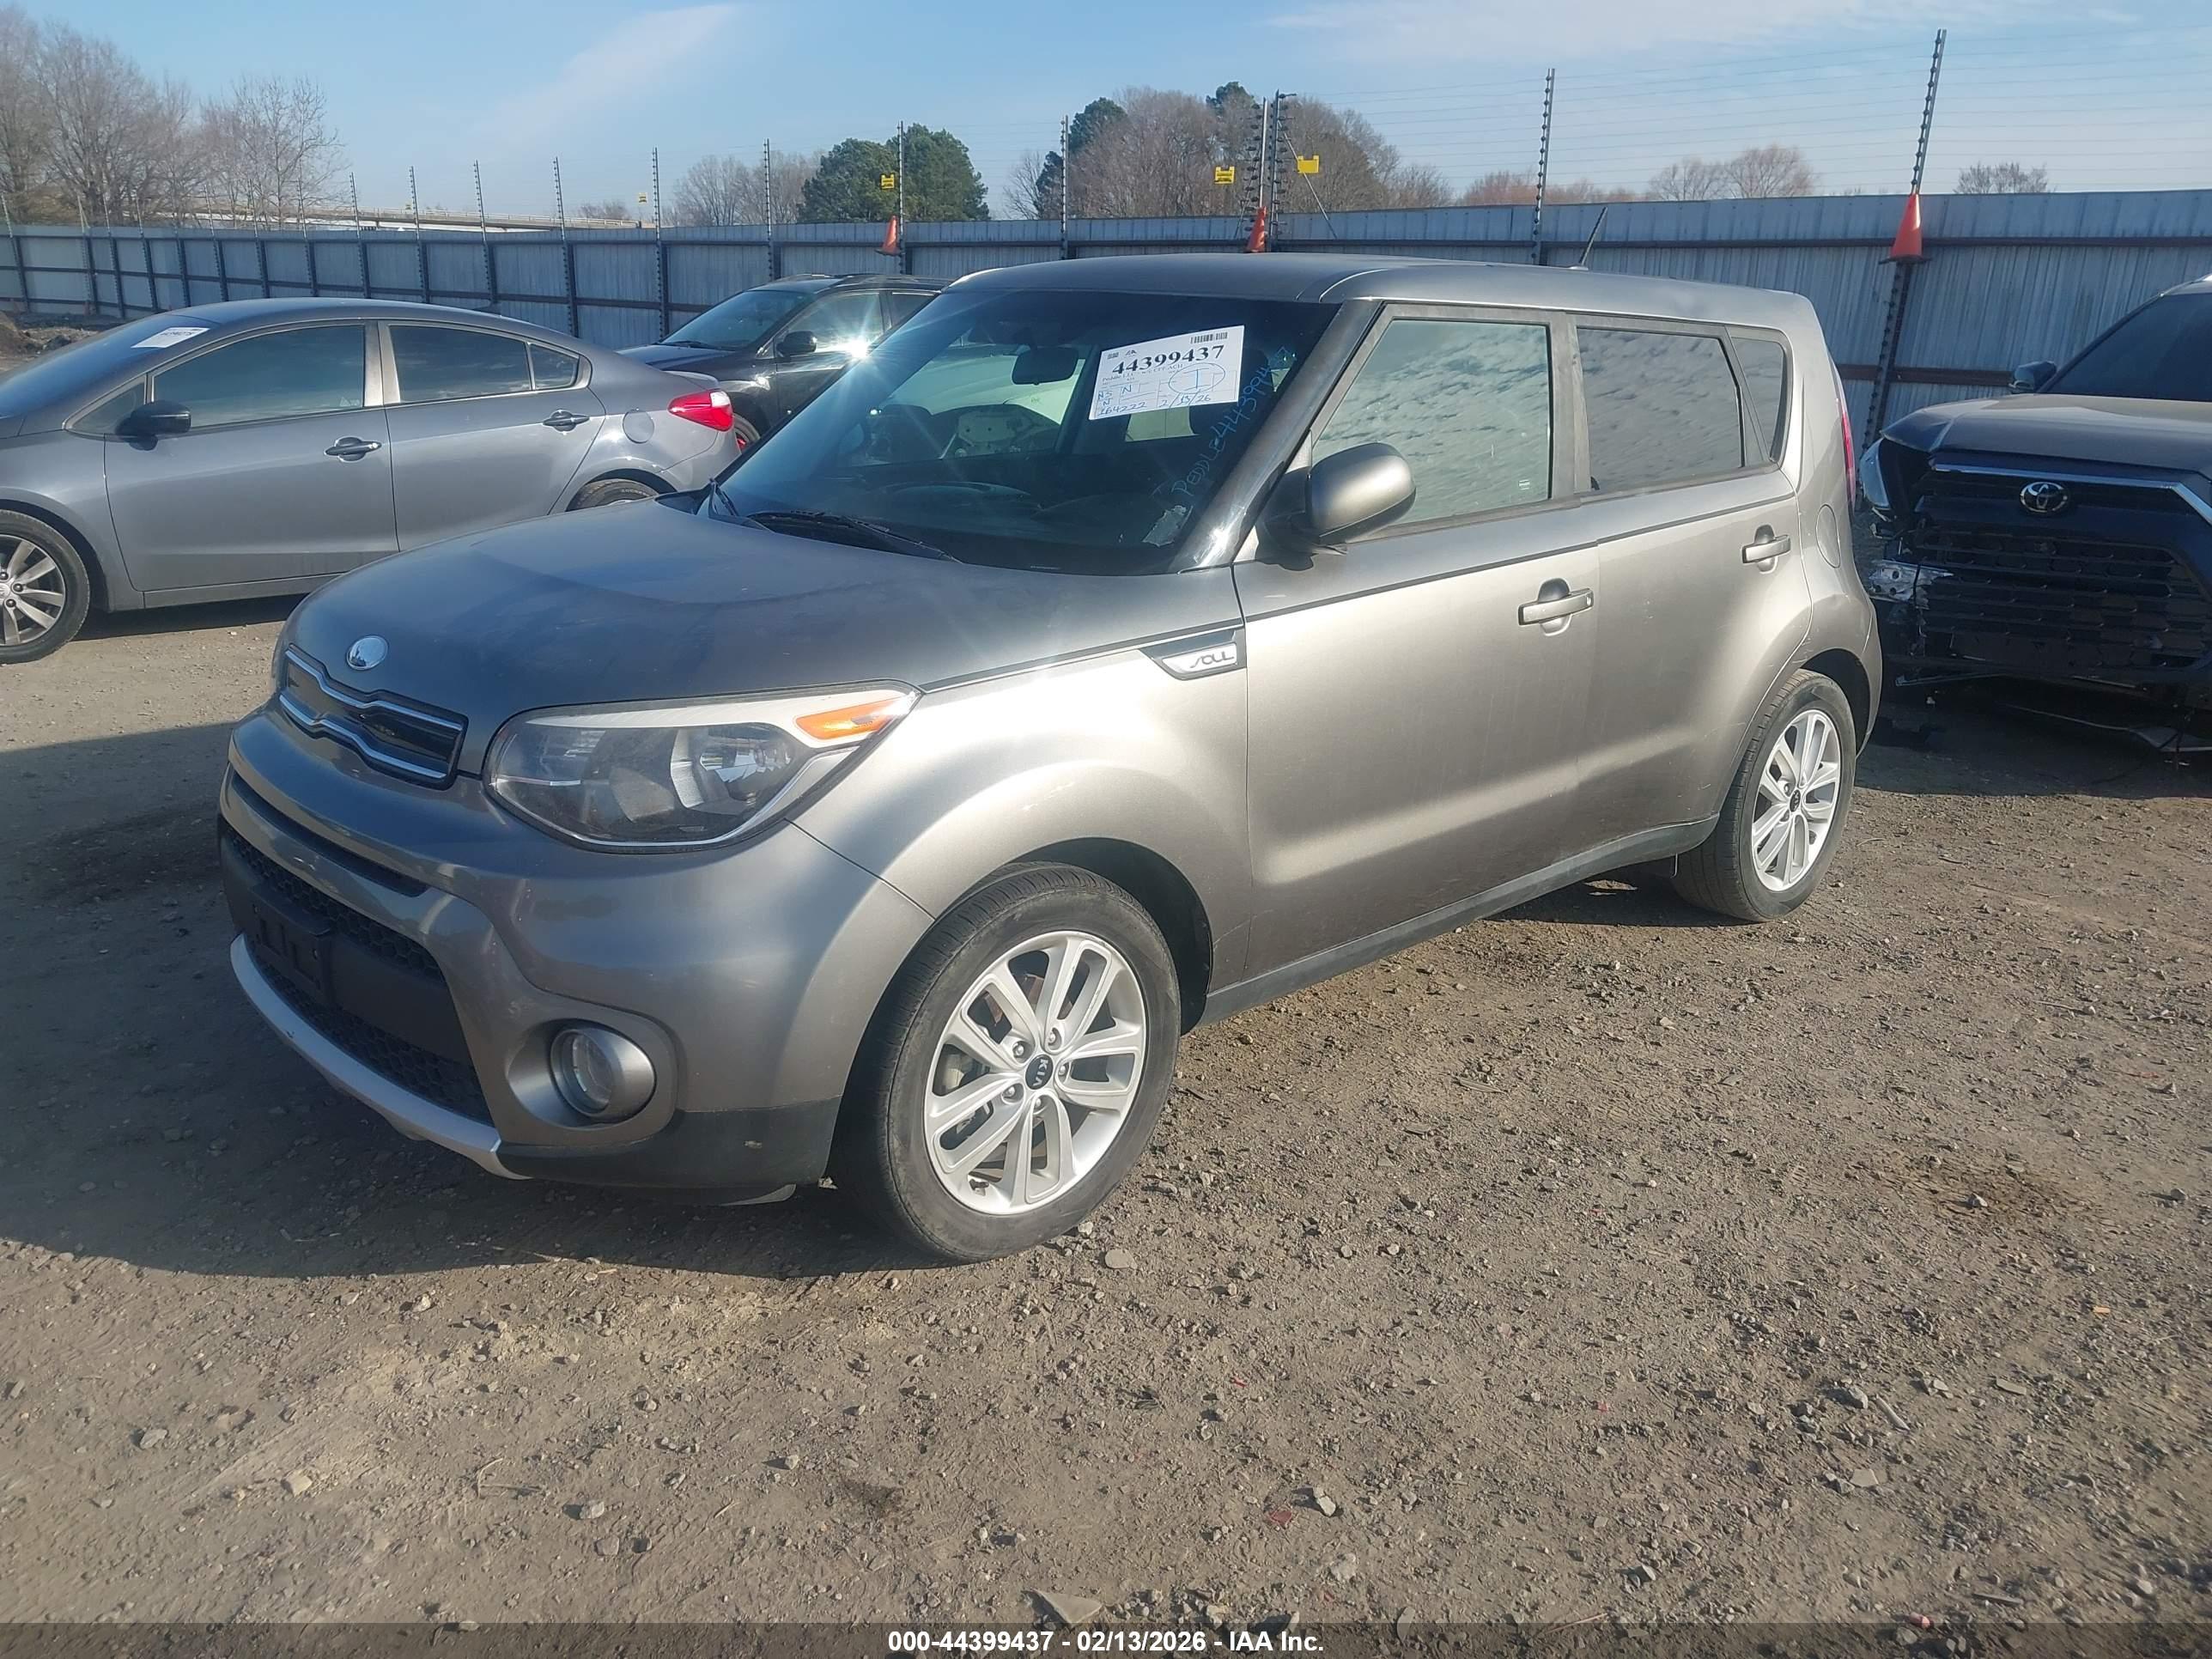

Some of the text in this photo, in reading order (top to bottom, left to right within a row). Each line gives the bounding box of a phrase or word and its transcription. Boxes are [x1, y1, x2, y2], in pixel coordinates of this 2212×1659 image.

[1112, 344, 1224, 374] 44399437
[1189, 651, 1235, 669] SOUL
[1032, 1059, 1048, 1086] KIA
